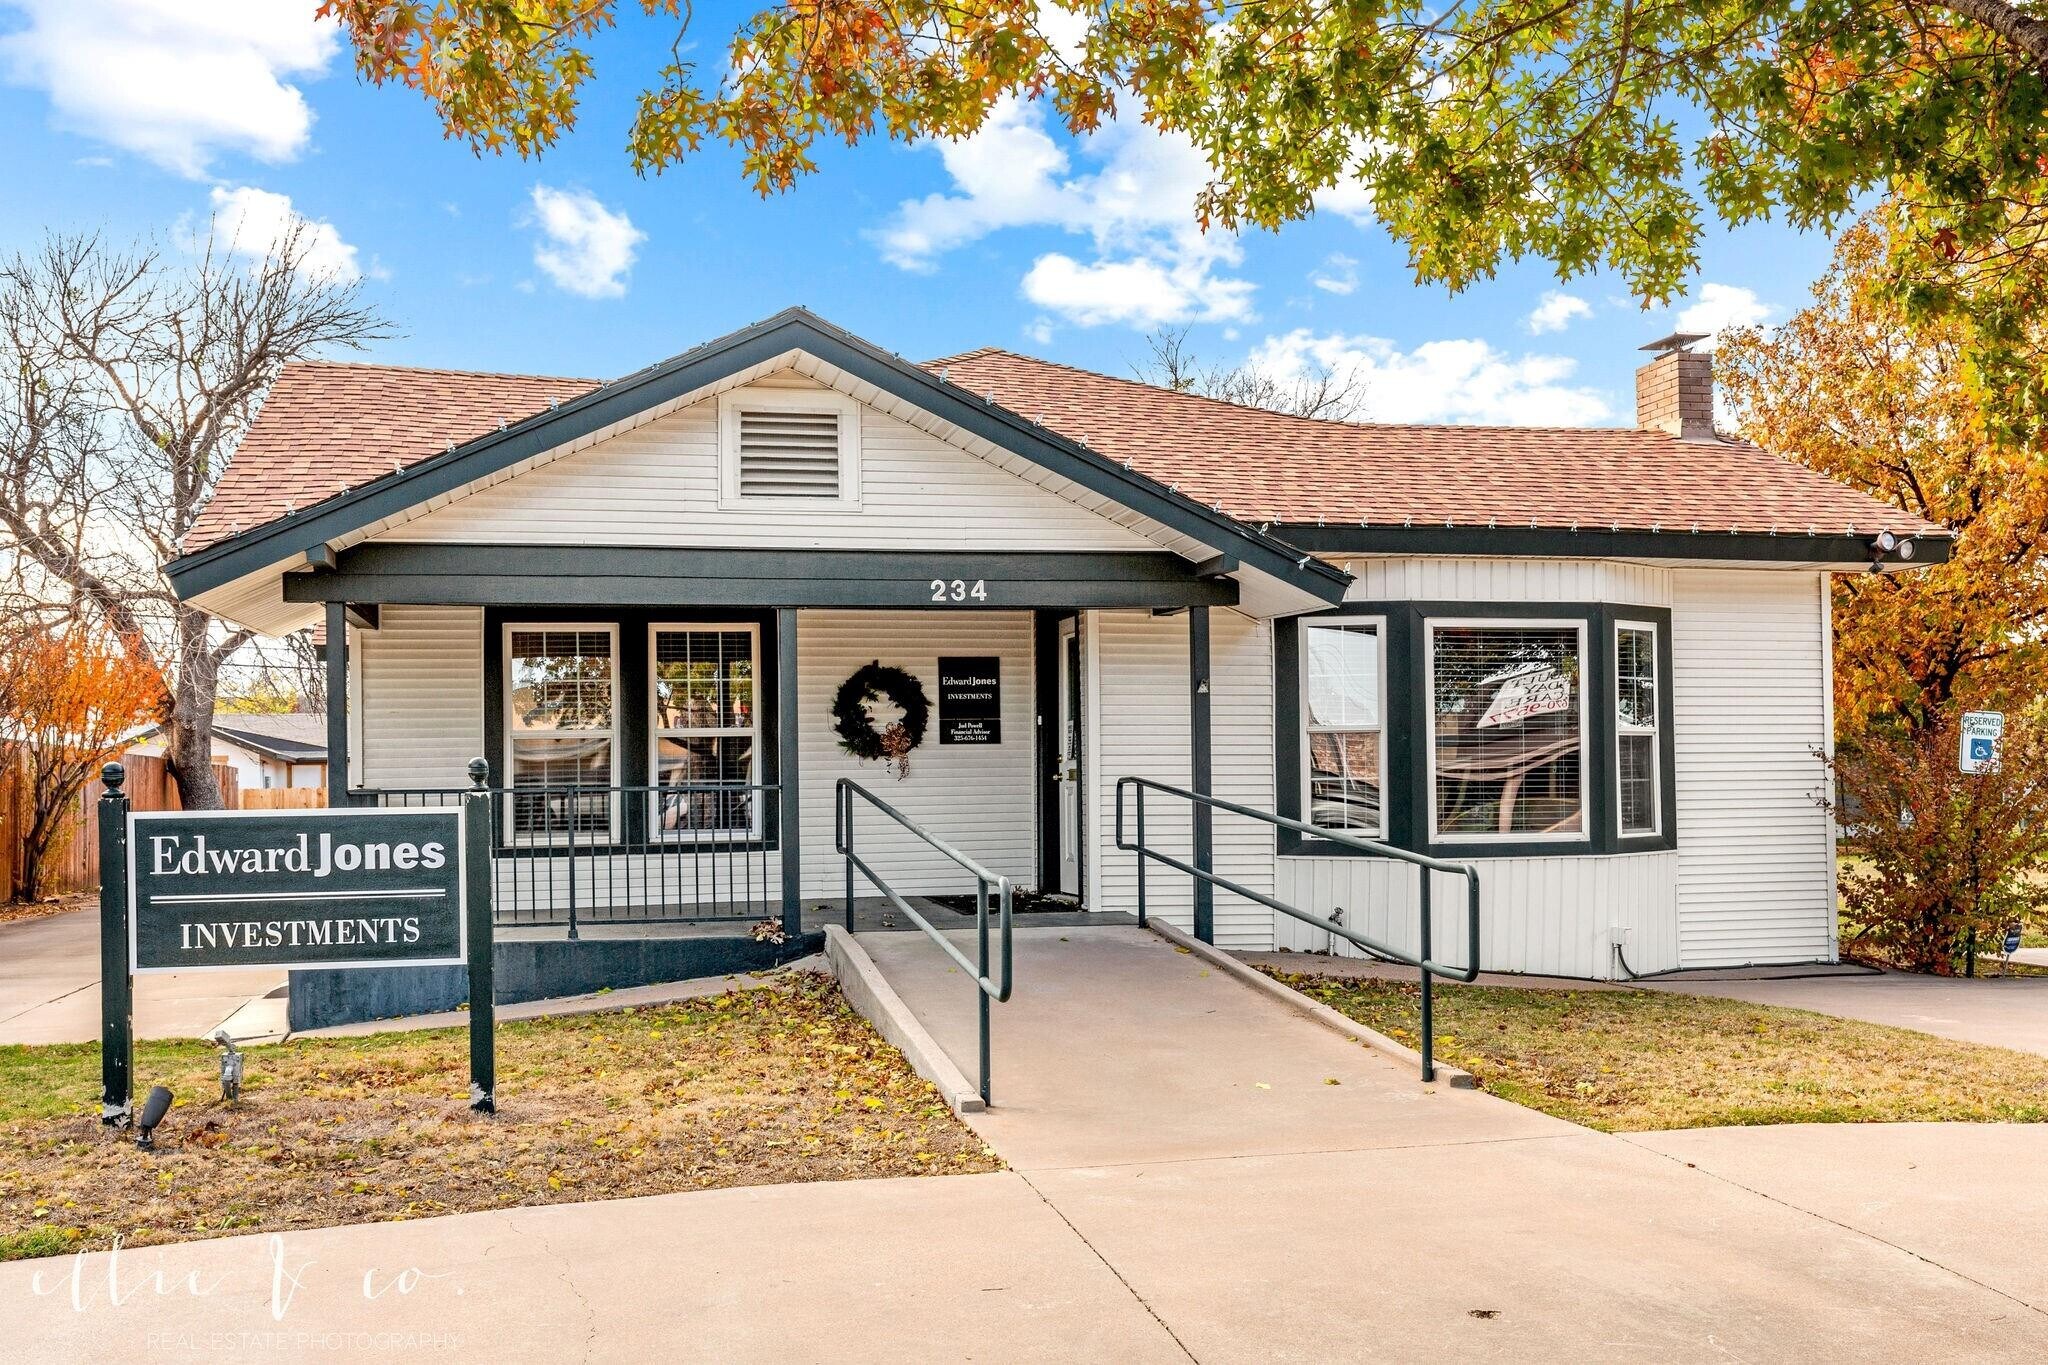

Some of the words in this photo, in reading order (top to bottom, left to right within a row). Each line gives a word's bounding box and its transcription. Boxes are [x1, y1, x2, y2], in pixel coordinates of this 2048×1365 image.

[930, 579, 988, 602] 234
[1965, 716, 2001, 727] RESERVED
[1967, 728, 1998, 736] PARKING
[180, 917, 421, 949] INVESTMENTS
